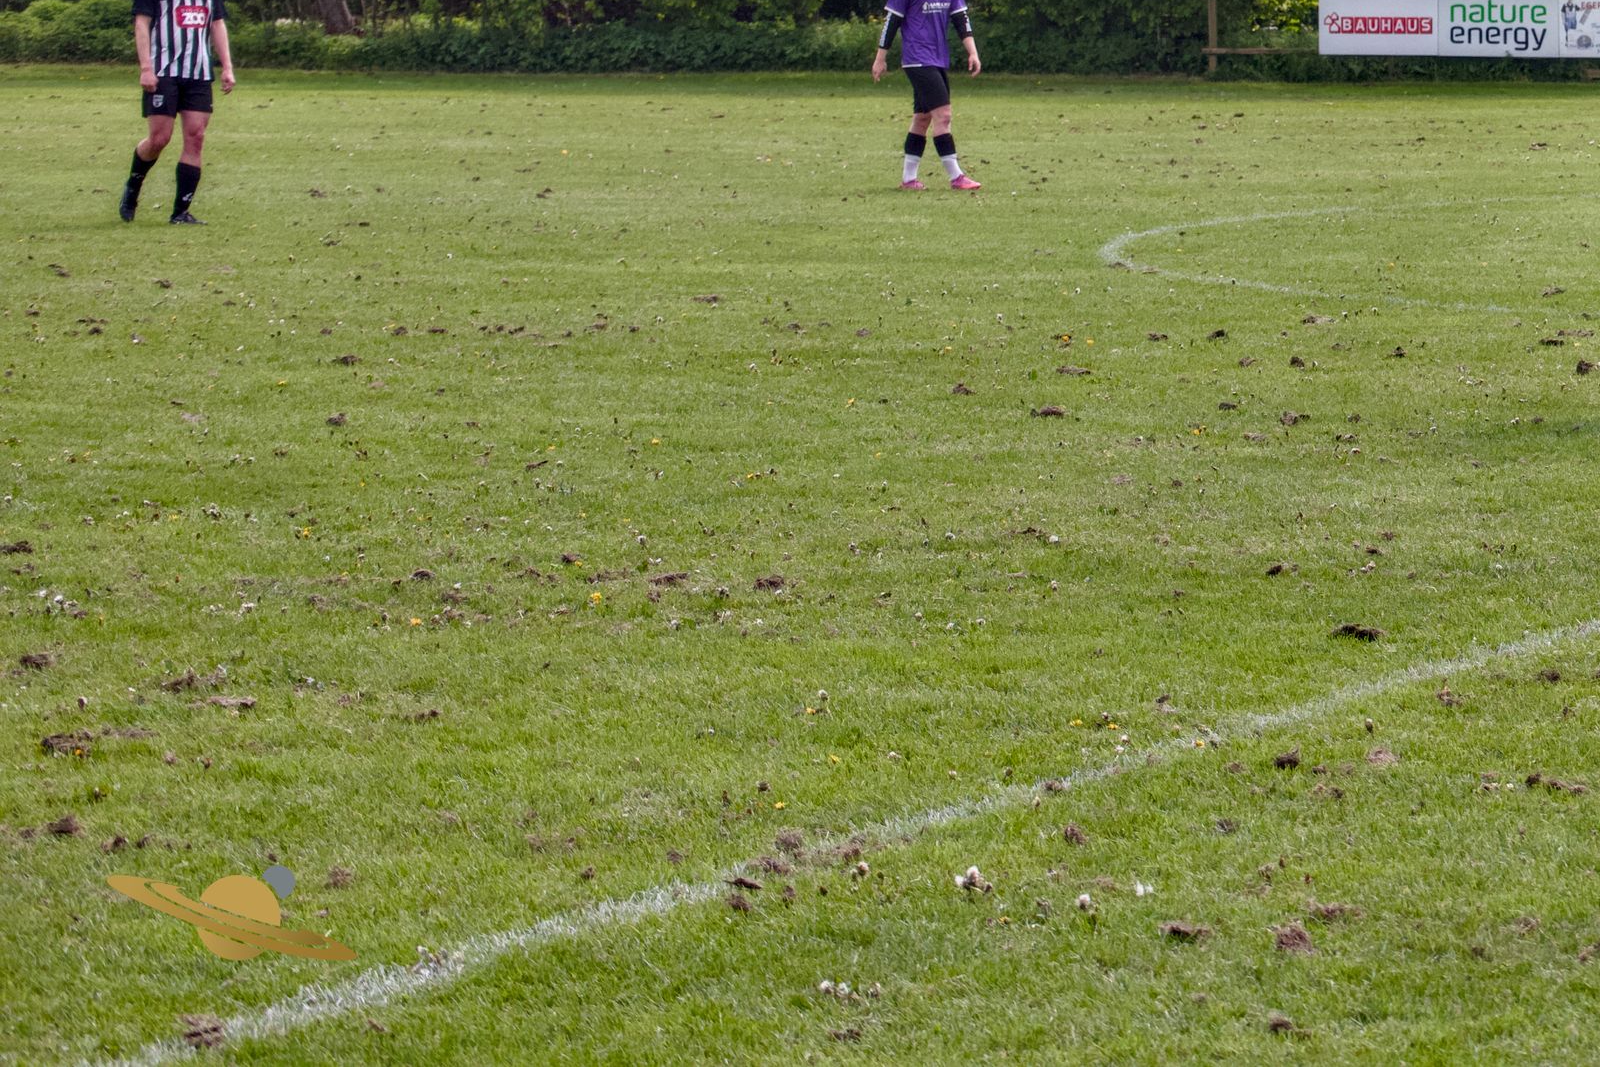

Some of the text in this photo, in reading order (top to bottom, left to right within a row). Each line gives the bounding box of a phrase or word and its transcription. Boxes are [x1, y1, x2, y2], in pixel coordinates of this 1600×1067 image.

[181, 12, 206, 25] ZOO
[1450, 0, 1547, 24] nature
[1341, 17, 1433, 34] BAUHAUS
[1450, 26, 1547, 51] energy
